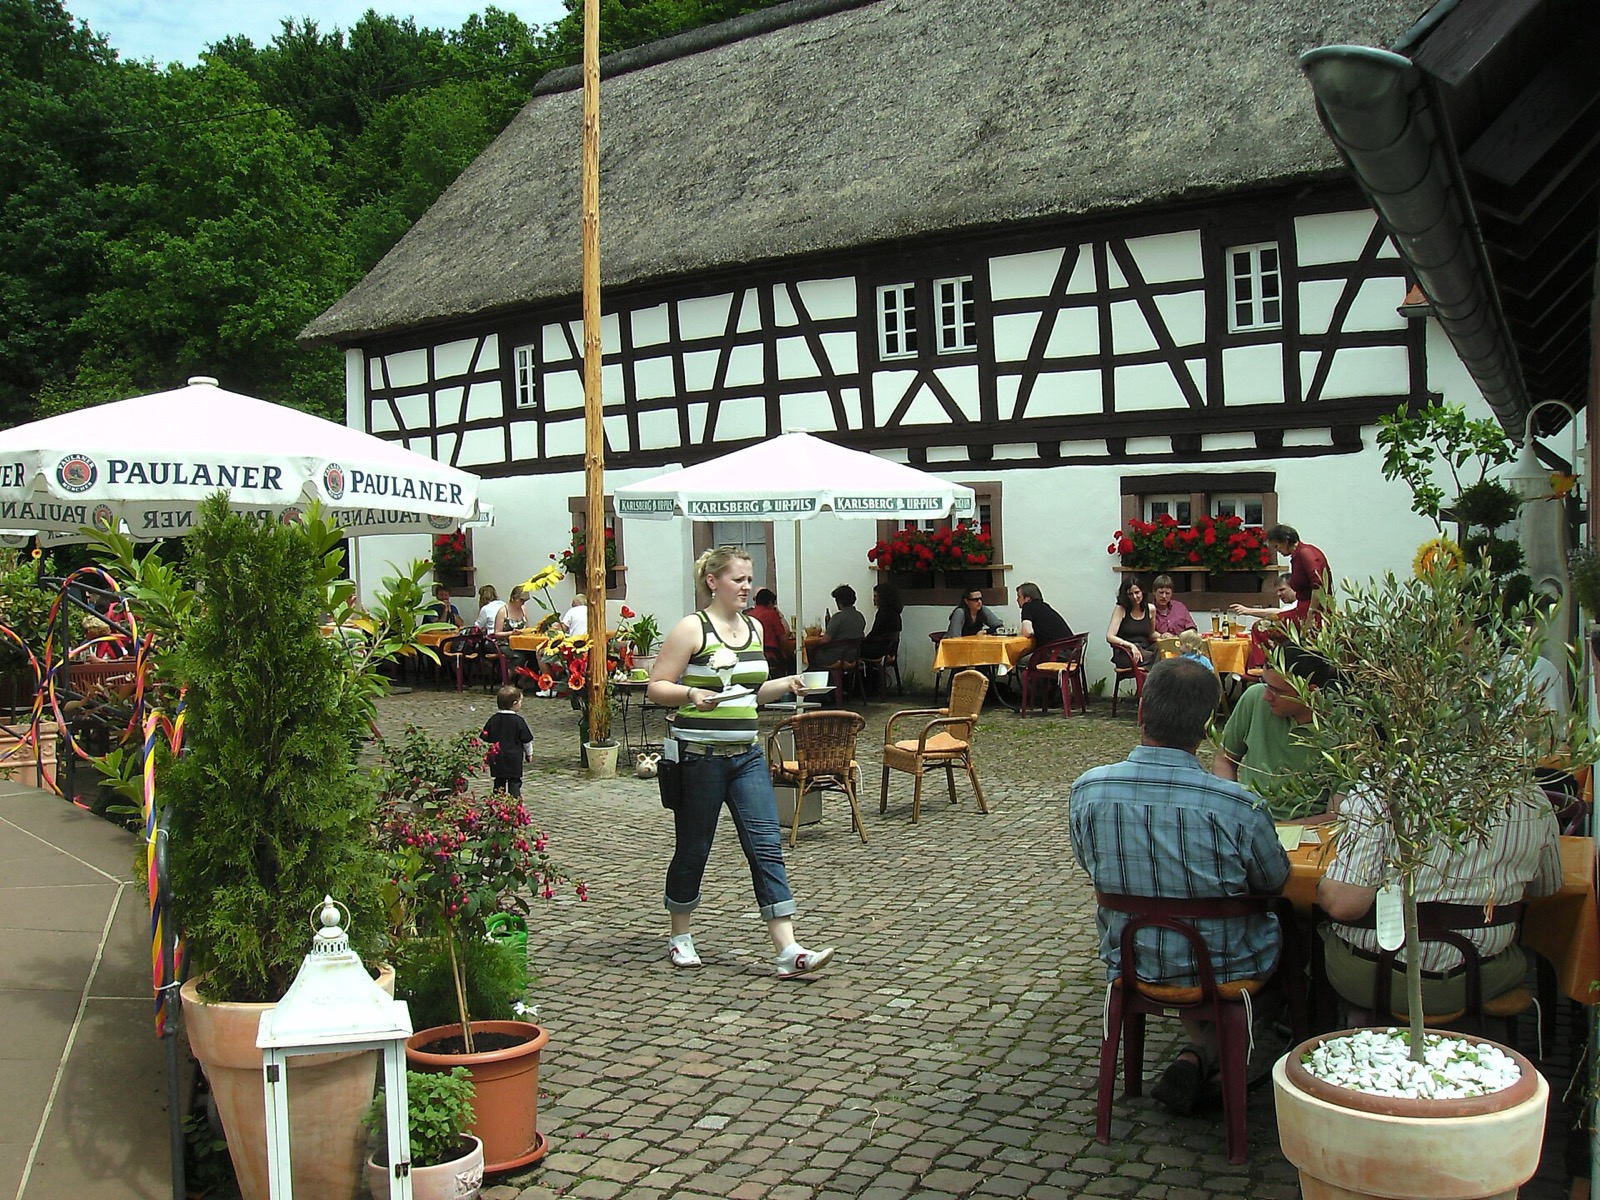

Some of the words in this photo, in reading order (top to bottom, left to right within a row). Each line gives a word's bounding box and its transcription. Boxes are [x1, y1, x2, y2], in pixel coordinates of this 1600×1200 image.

[58, 454, 95, 469] PAULANER
[0, 462, 25, 487] ER
[107, 459, 283, 490] PAULANER
[350, 470, 464, 505] PAULANER
[621, 500, 651, 511] KARLSBERG
[692, 500, 759, 513] KARLSBERG
[775, 499, 812, 511] UR-PILS
[837, 498, 894, 510] KARLSBERG
[907, 498, 939, 509] UR-PILS
